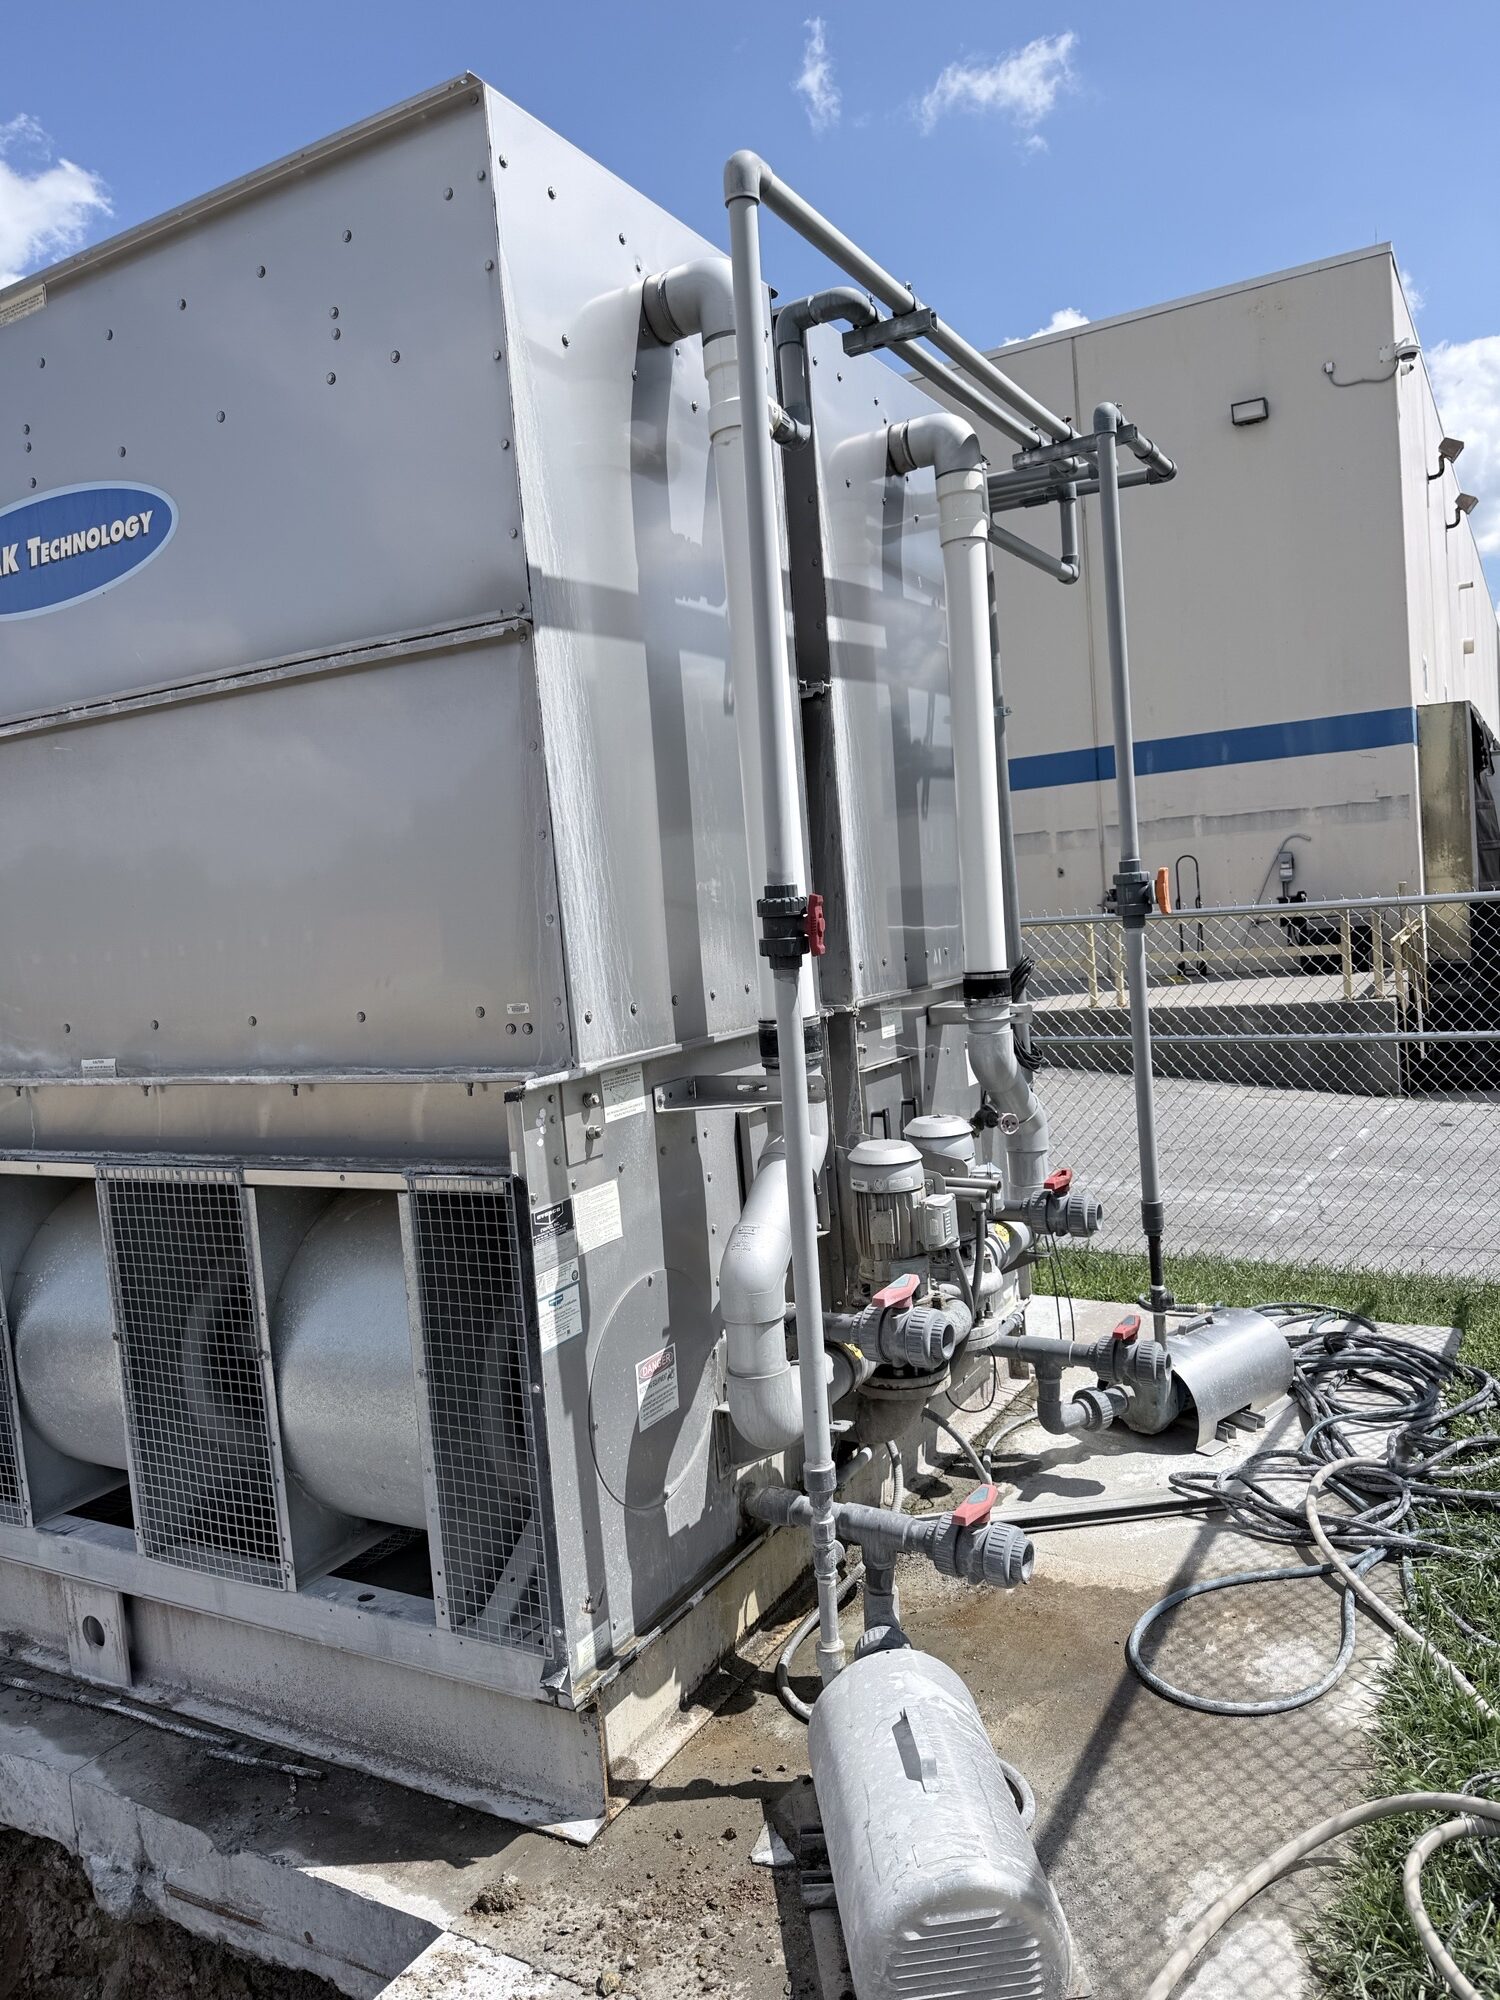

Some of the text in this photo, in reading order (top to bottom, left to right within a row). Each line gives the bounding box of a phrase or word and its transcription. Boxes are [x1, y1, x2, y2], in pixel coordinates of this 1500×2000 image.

[0, 510, 153, 576] K TECHNOLOGY
[642, 1353, 671, 1377] DANGER
